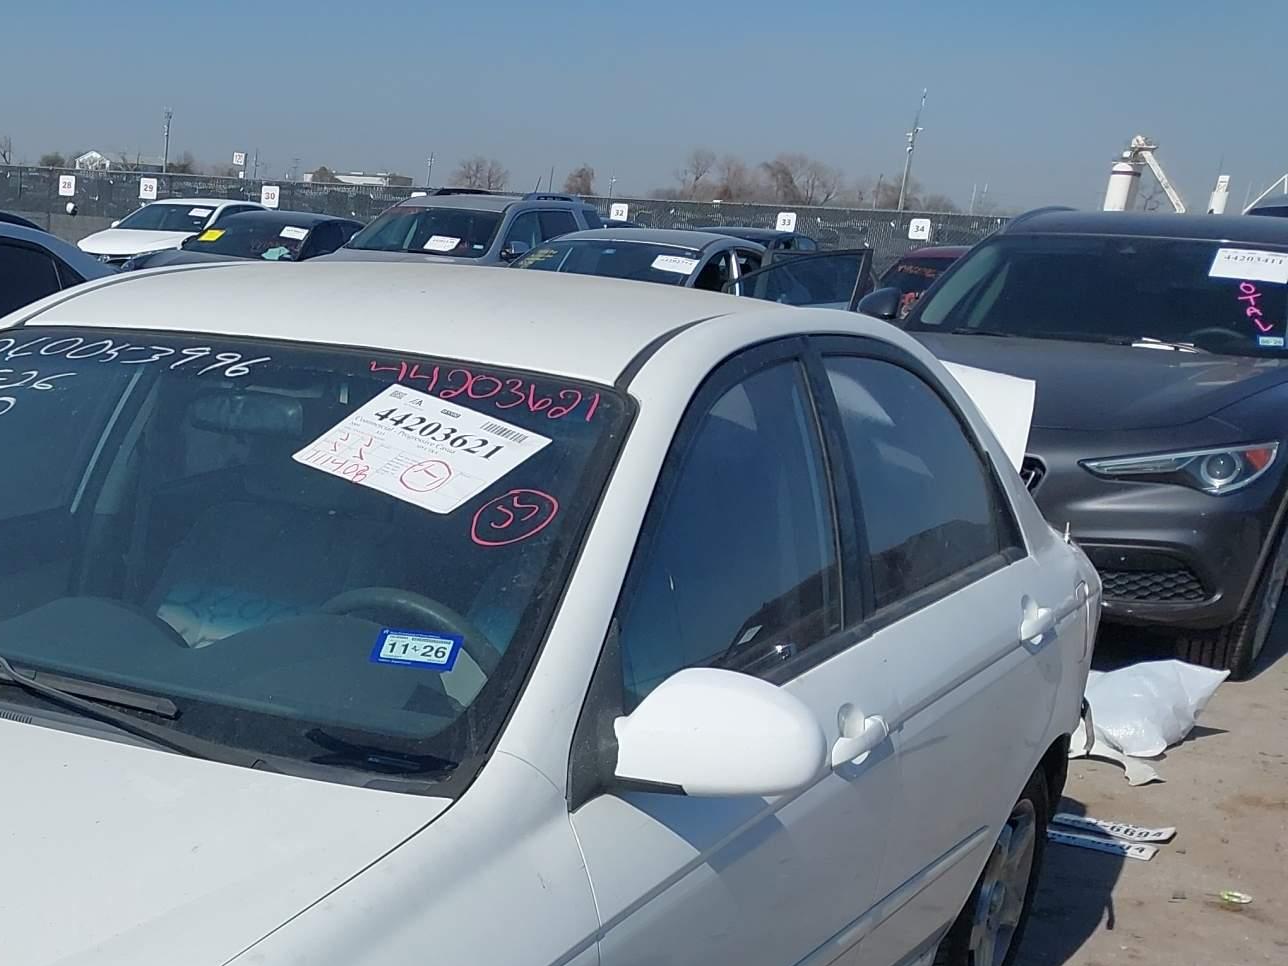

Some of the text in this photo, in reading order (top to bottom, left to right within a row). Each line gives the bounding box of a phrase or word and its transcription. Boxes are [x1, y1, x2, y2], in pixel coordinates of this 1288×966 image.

[62, 181, 72, 189] 28
[143, 184, 154, 192] 29
[264, 192, 276, 200] 30
[614, 209, 624, 217] 32
[781, 218, 792, 226] 33
[913, 225, 925, 233] 34
[369, 360, 600, 422] 44203621
[374, 407, 504, 460] 44203621
